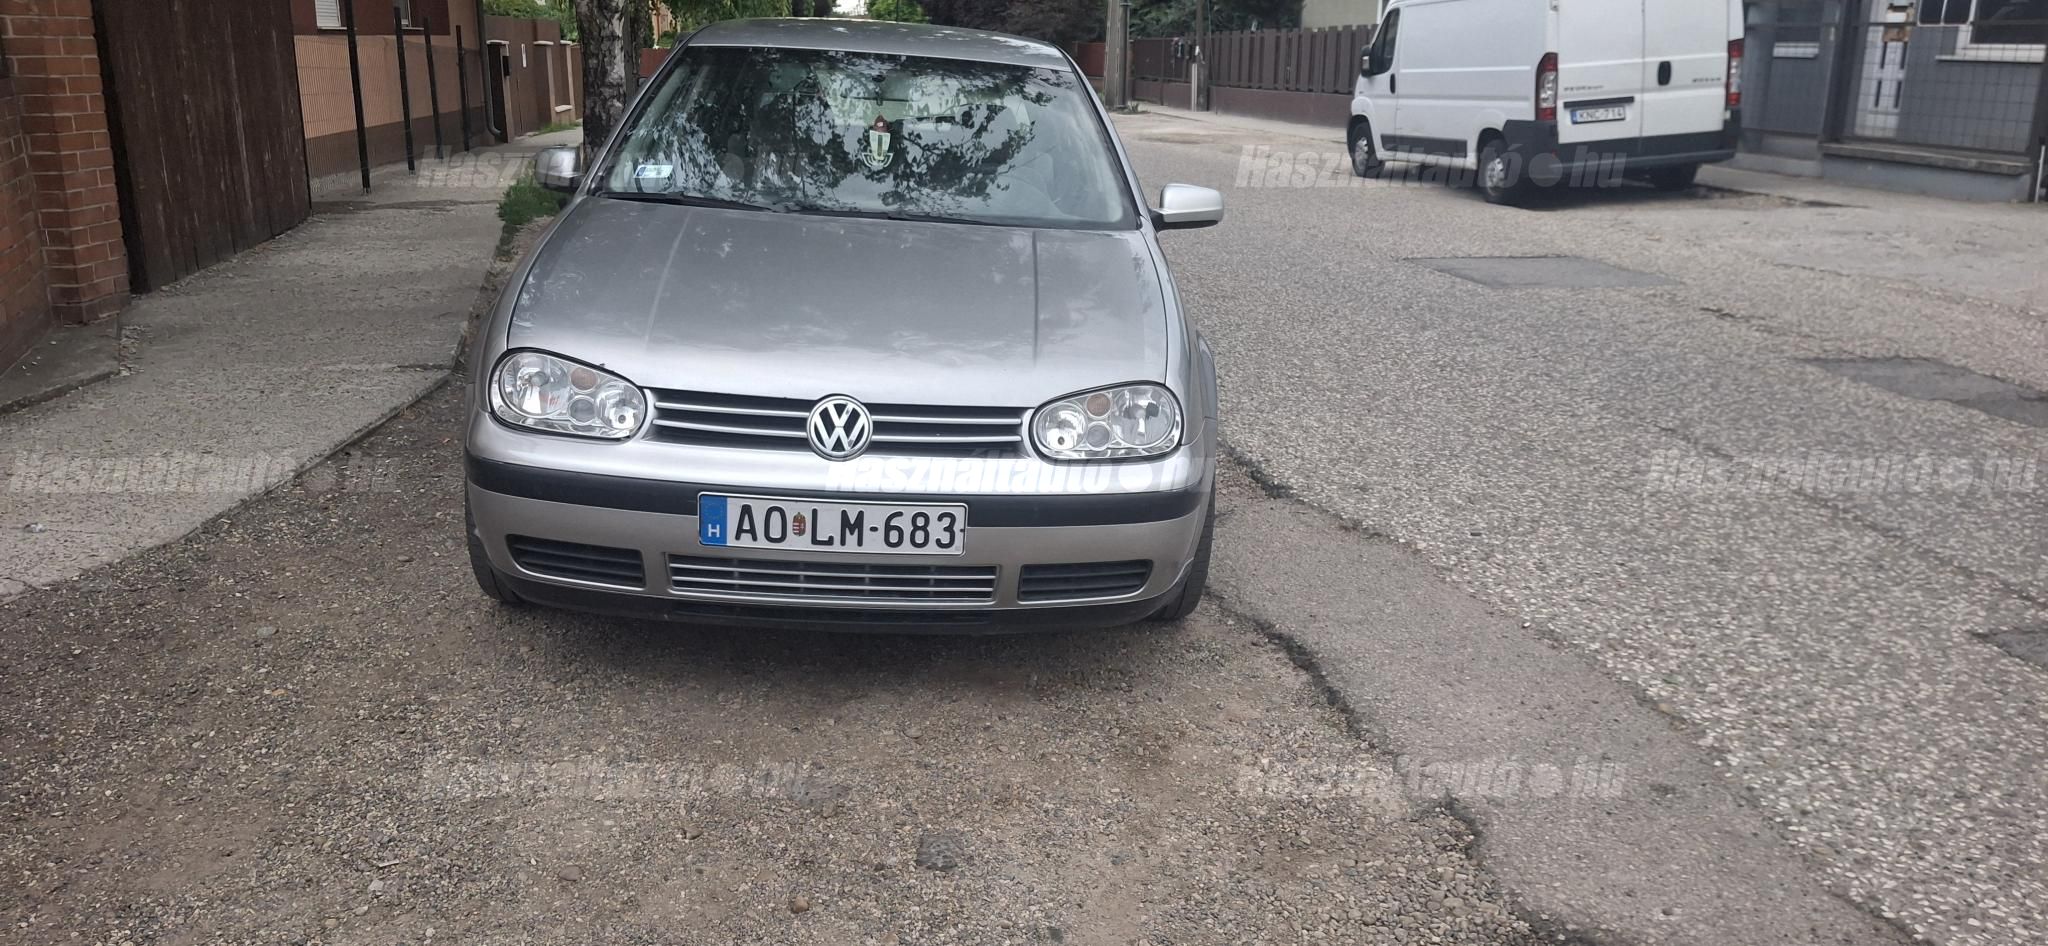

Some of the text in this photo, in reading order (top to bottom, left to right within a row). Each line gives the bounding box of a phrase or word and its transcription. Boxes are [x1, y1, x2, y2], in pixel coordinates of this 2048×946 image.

[809, 398, 869, 456] VW
[707, 503, 957, 549] H AO LM-683
